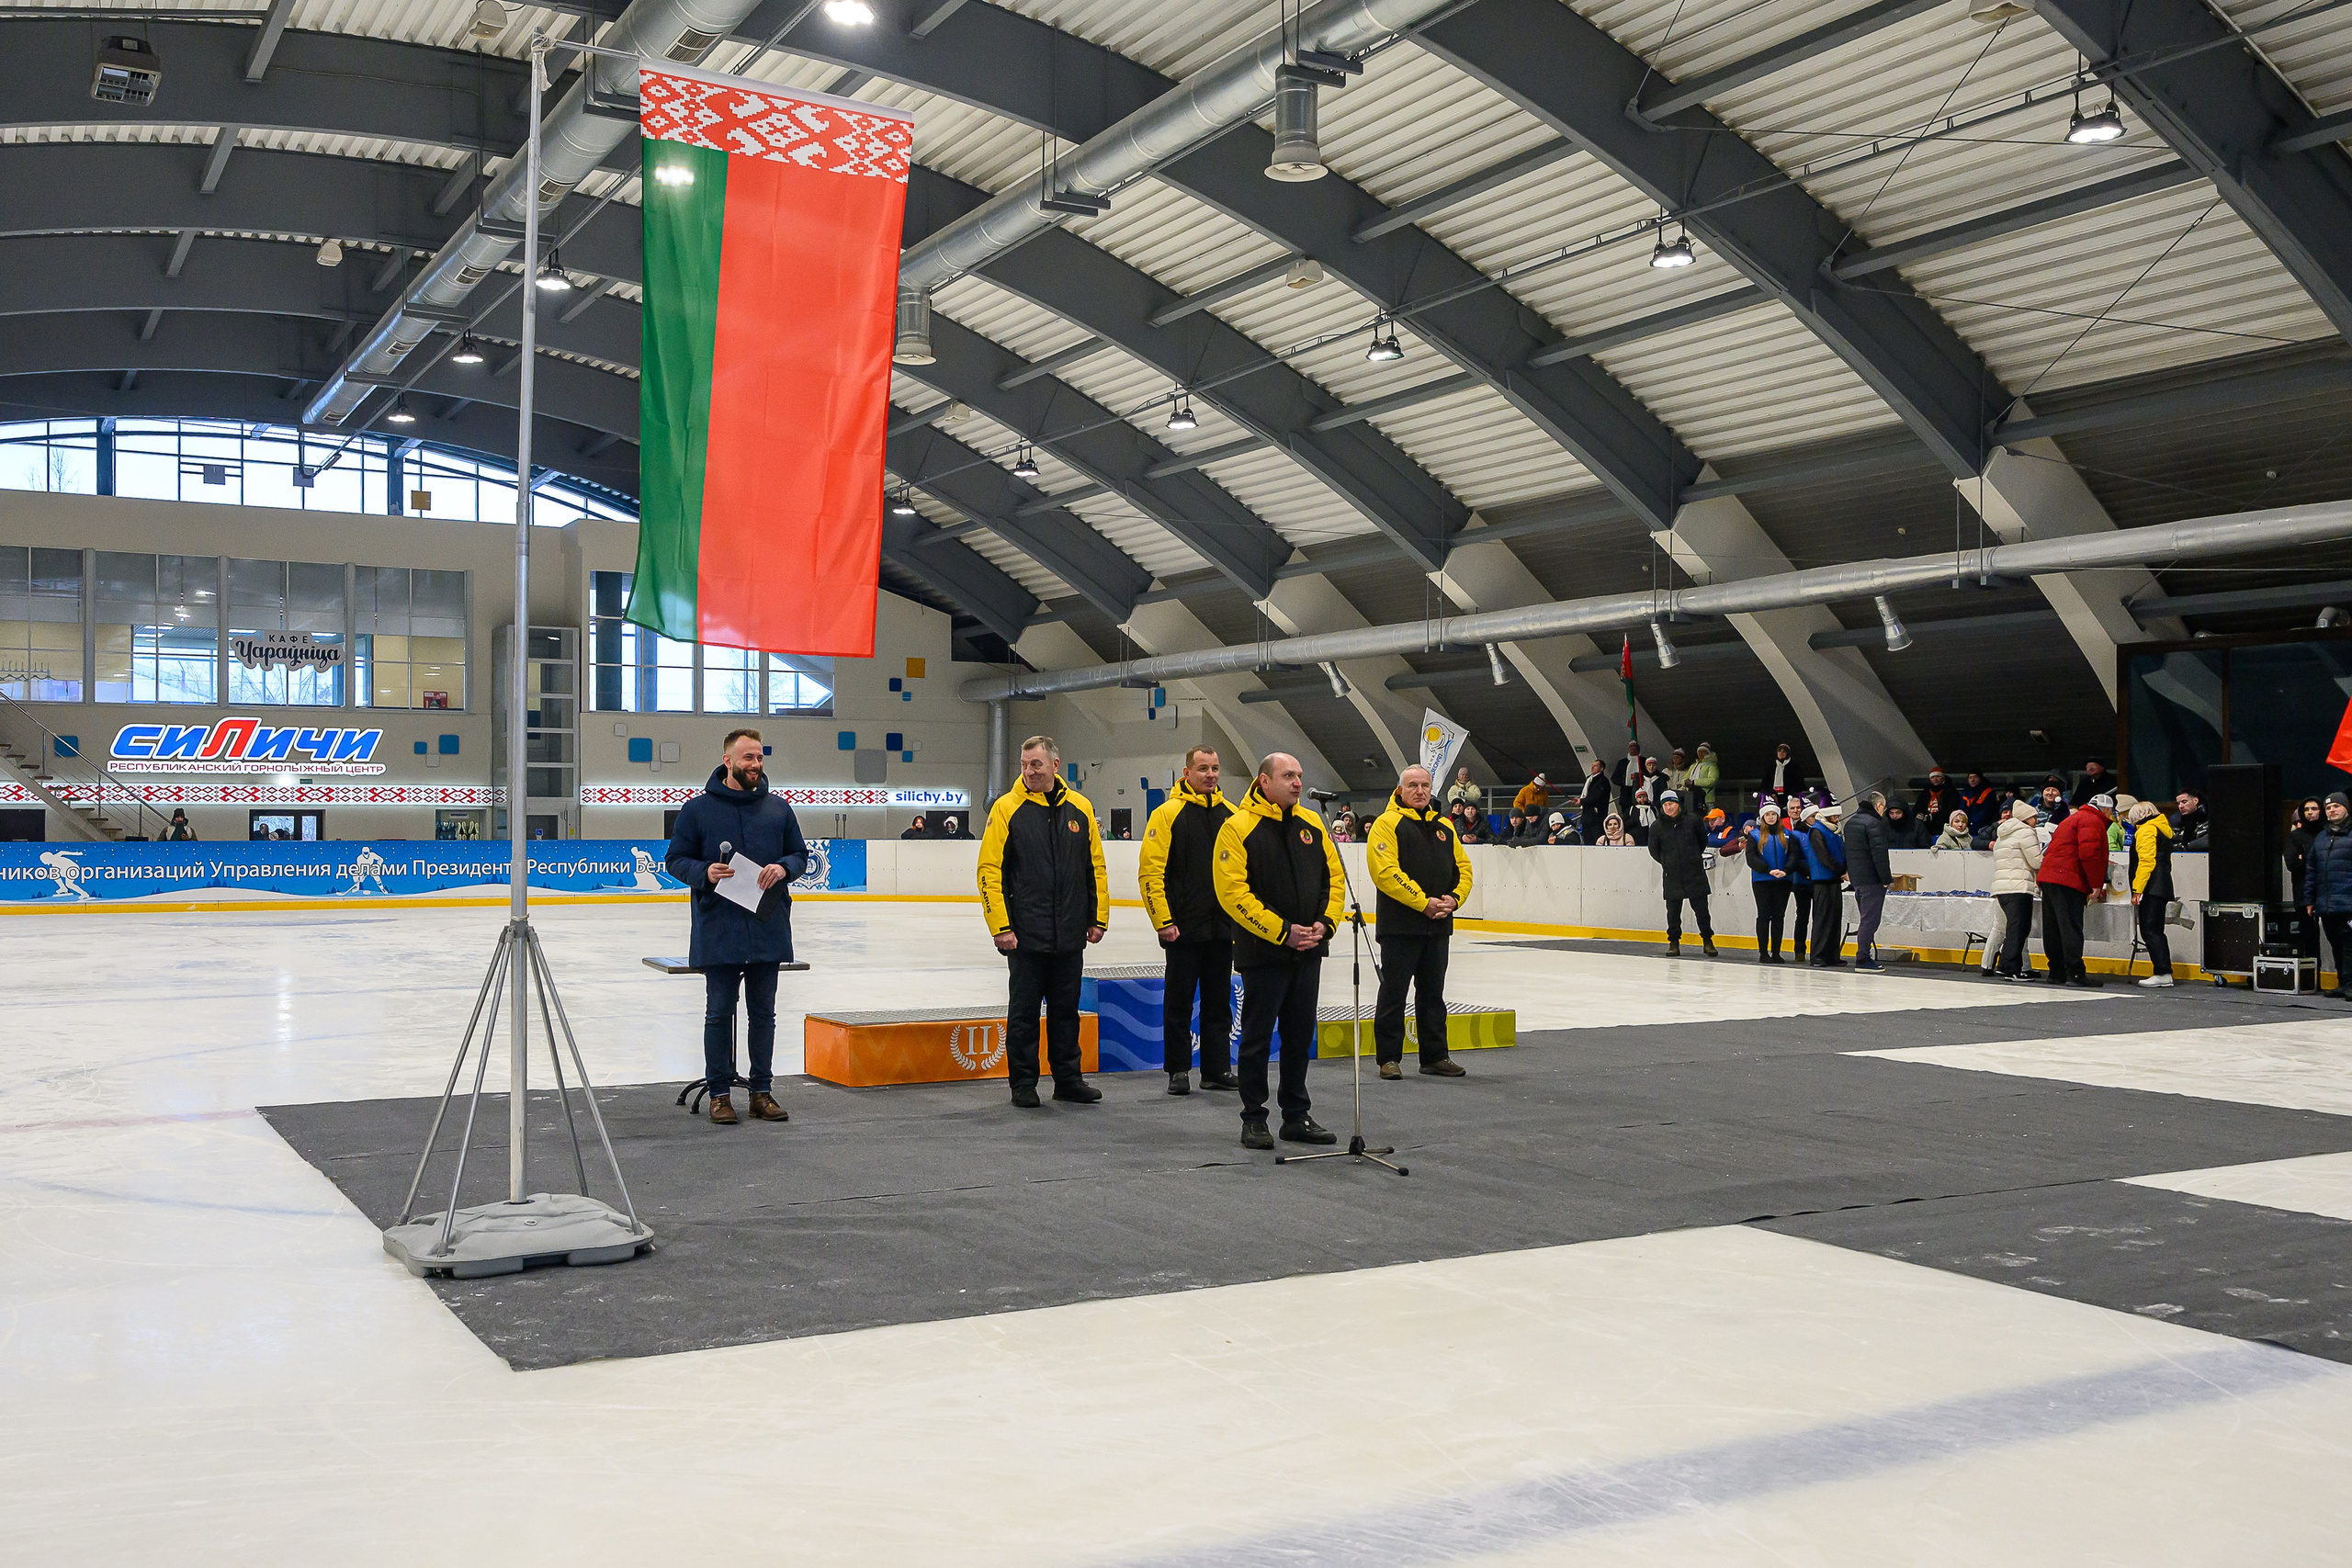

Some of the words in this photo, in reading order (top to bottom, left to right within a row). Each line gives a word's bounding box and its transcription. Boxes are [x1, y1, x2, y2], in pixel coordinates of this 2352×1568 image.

[268, 634, 309, 644] КАФЕ
[109, 762, 242, 772] РЕСПУБЛИКАНСКИЙ
[243, 763, 344, 773] ГОРНОЛЫЖНЫЙ
[345, 765, 384, 773] ЦЕНТР
[895, 791, 964, 804] silichy.by
[65, 861, 205, 884] организаций
[209, 860, 331, 882] Управления
[335, 863, 408, 879] делами
[413, 859, 512, 879] Президент
[526, 857, 630, 878] Республики
[635, 857, 668, 874] Бел
[1392, 873, 1419, 897] BELARUS
[1145, 881, 1157, 916] BELARUS
[1236, 903, 1270, 934] BELARUS
[965, 1025, 993, 1055] II
